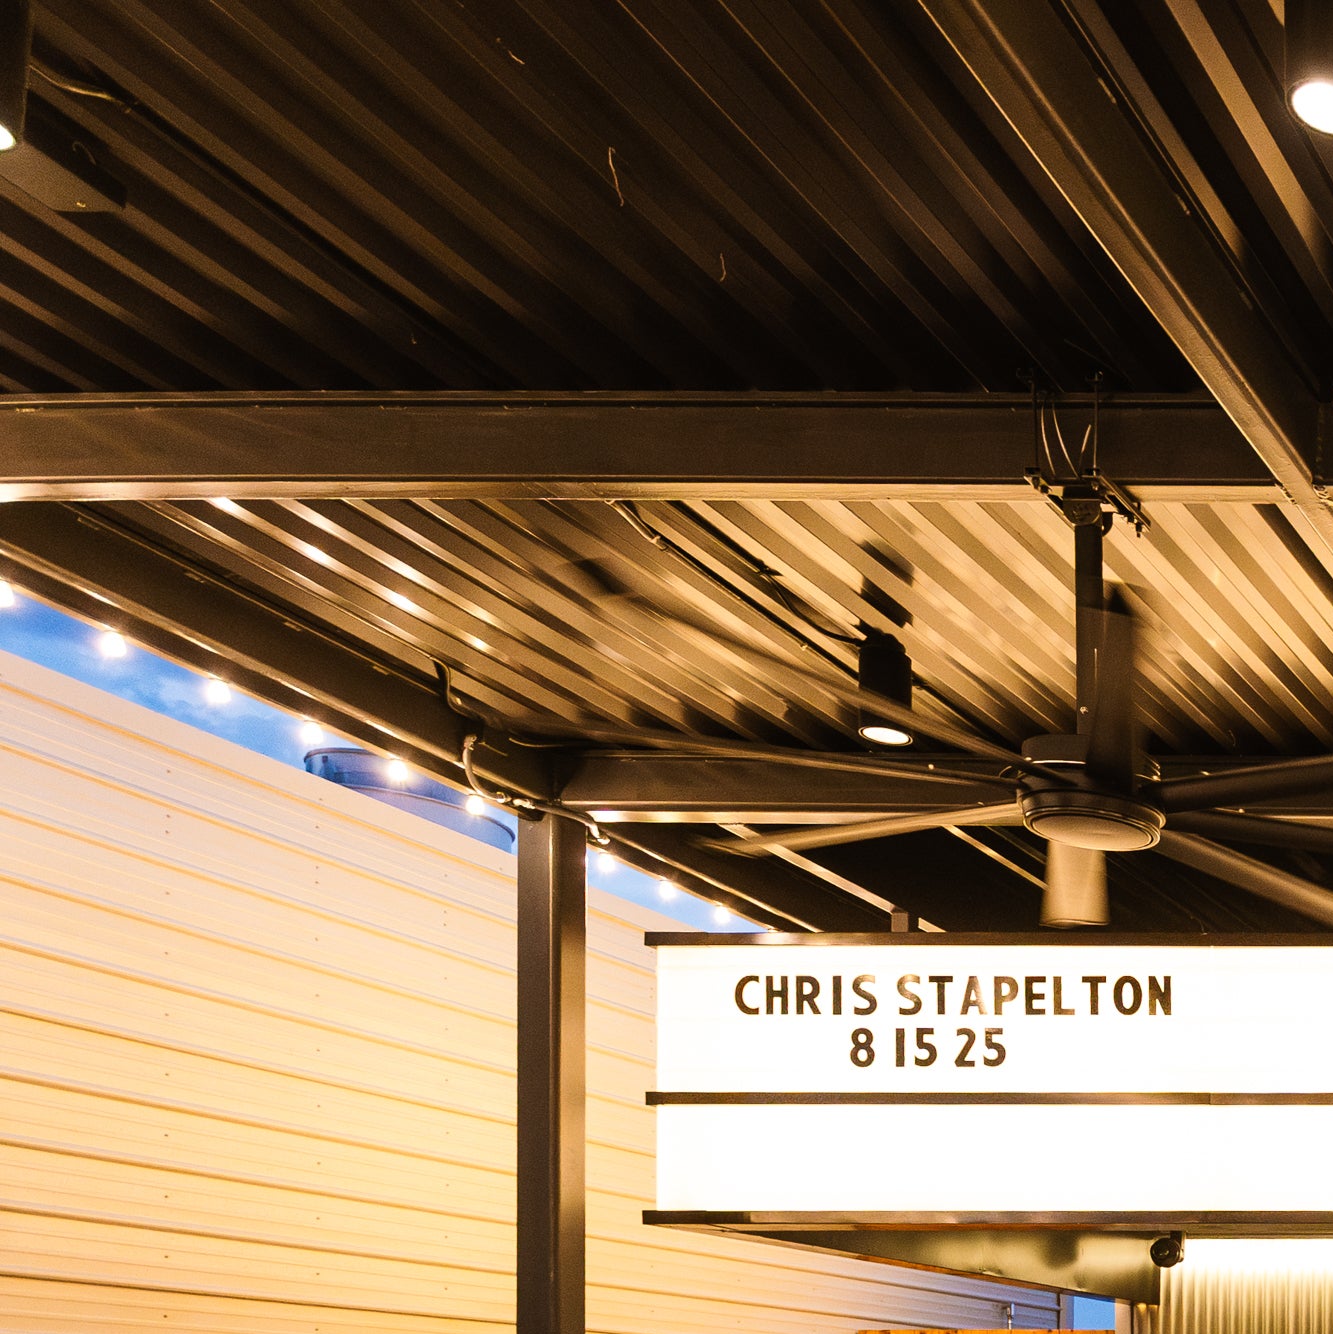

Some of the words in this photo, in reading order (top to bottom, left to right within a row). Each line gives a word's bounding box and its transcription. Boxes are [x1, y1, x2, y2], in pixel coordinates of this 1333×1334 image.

[734, 975, 878, 1016] CHRIS
[896, 975, 1172, 1016] STAPELTON
[849, 1027, 876, 1068] 8
[895, 1027, 938, 1068] 15
[954, 1027, 1007, 1068] 25
